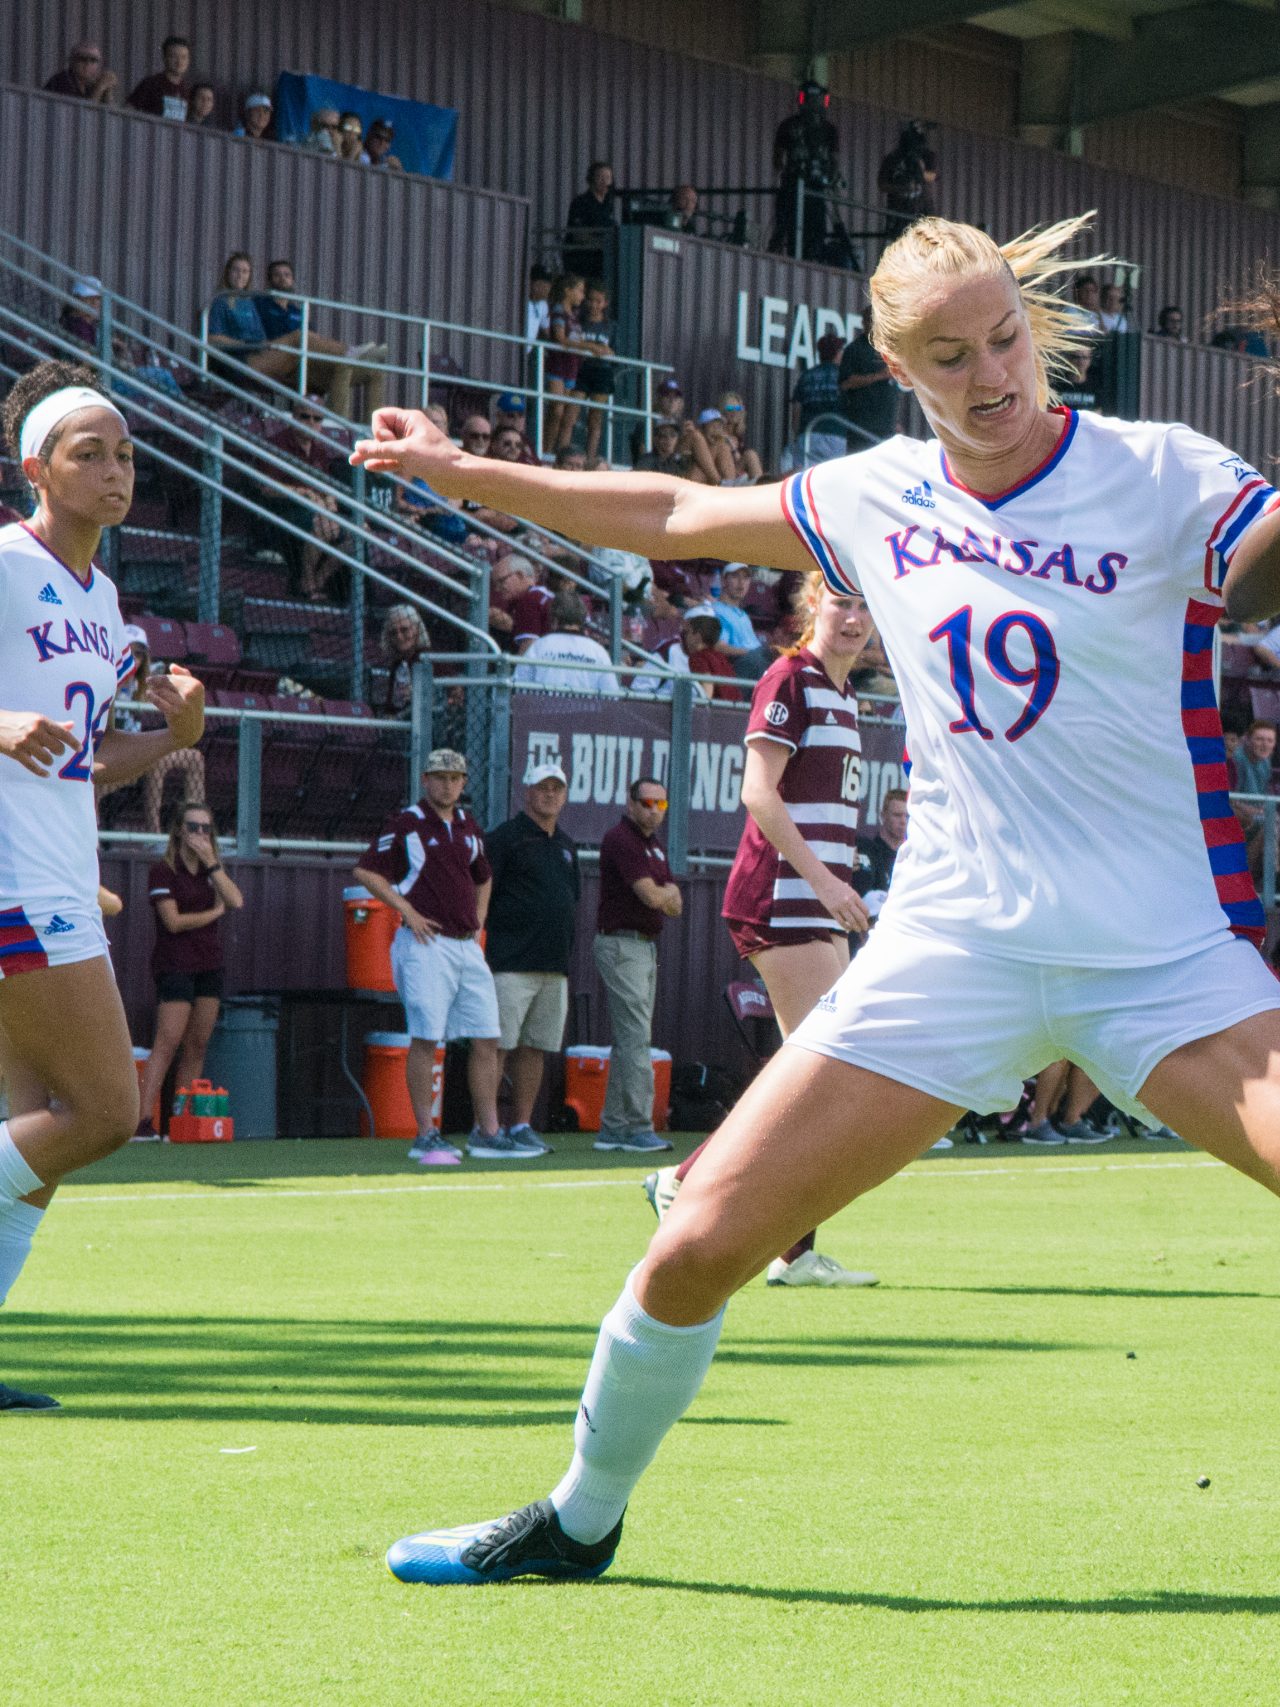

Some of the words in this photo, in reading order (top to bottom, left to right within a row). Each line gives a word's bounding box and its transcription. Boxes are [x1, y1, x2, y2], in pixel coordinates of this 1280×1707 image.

[901, 495, 936, 508] adidas
[884, 524, 1129, 595] KANSAS
[26, 619, 115, 665] KANS
[928, 604, 1060, 742] 19
[841, 752, 861, 802] 16
